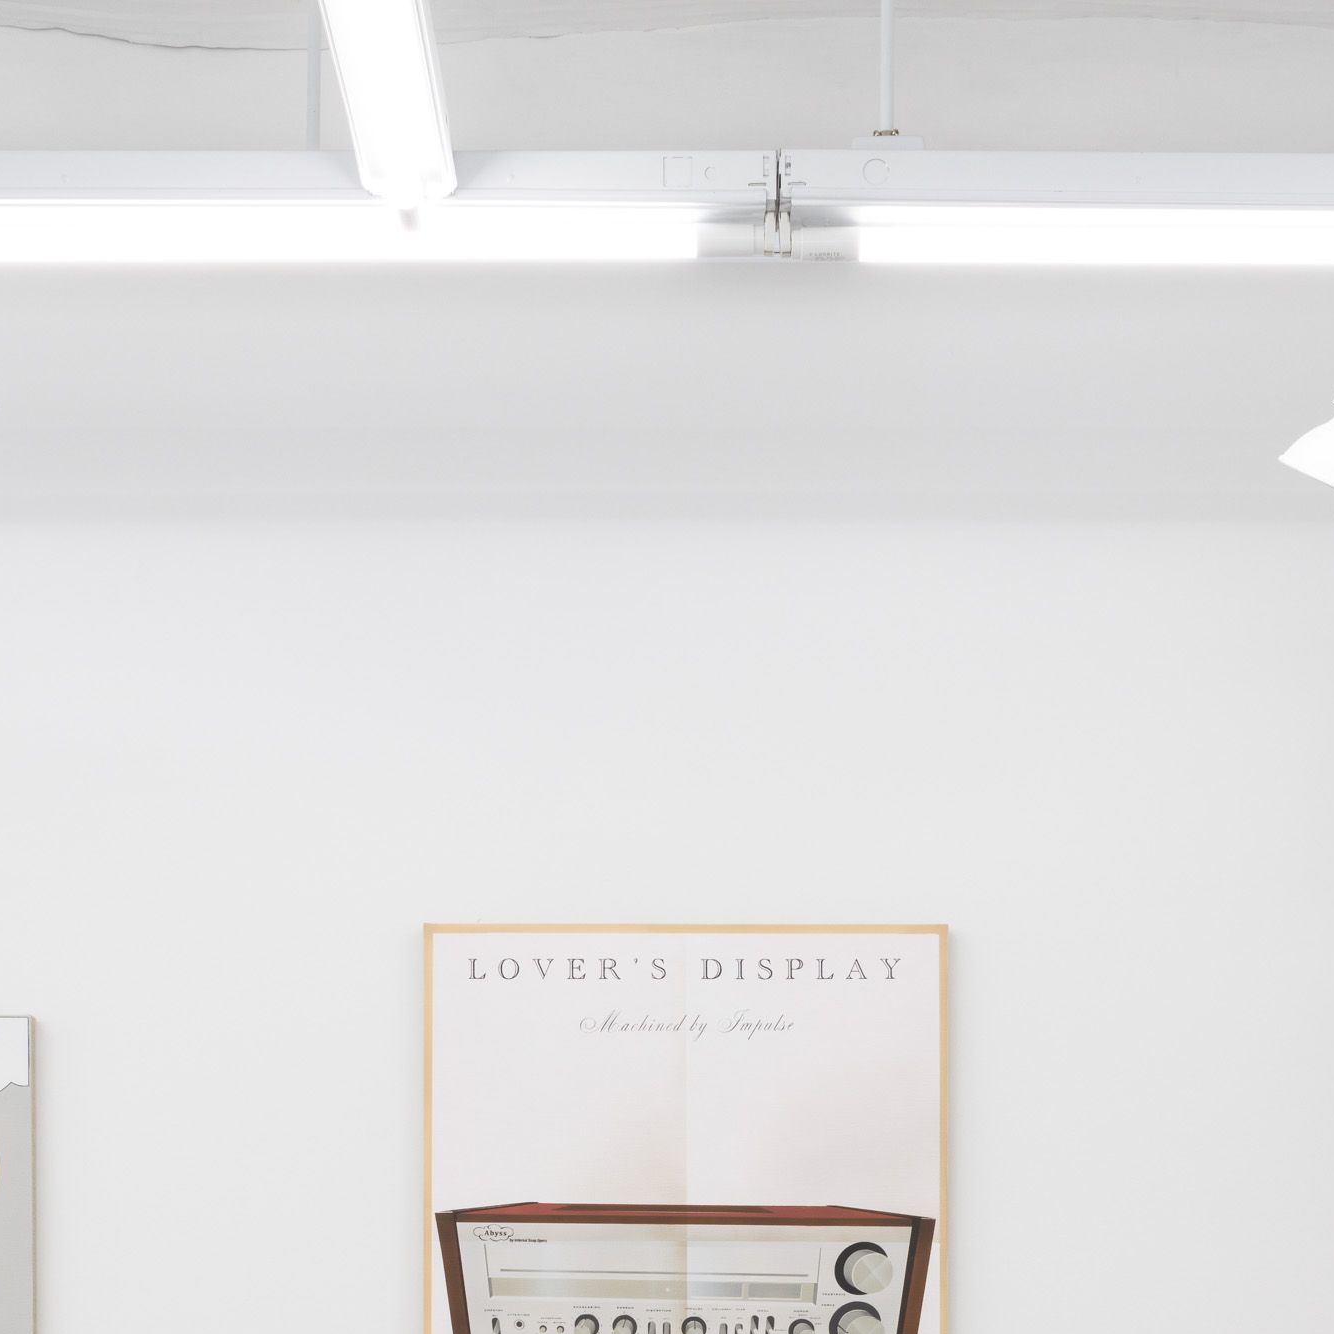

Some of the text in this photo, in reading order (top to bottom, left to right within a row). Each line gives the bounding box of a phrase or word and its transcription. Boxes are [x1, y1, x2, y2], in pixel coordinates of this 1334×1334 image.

[467, 957, 903, 981] LOVER'S DISPLAY
[578, 1007, 796, 1042] Machined by Impulse
[484, 1230, 508, 1238] Abyss
